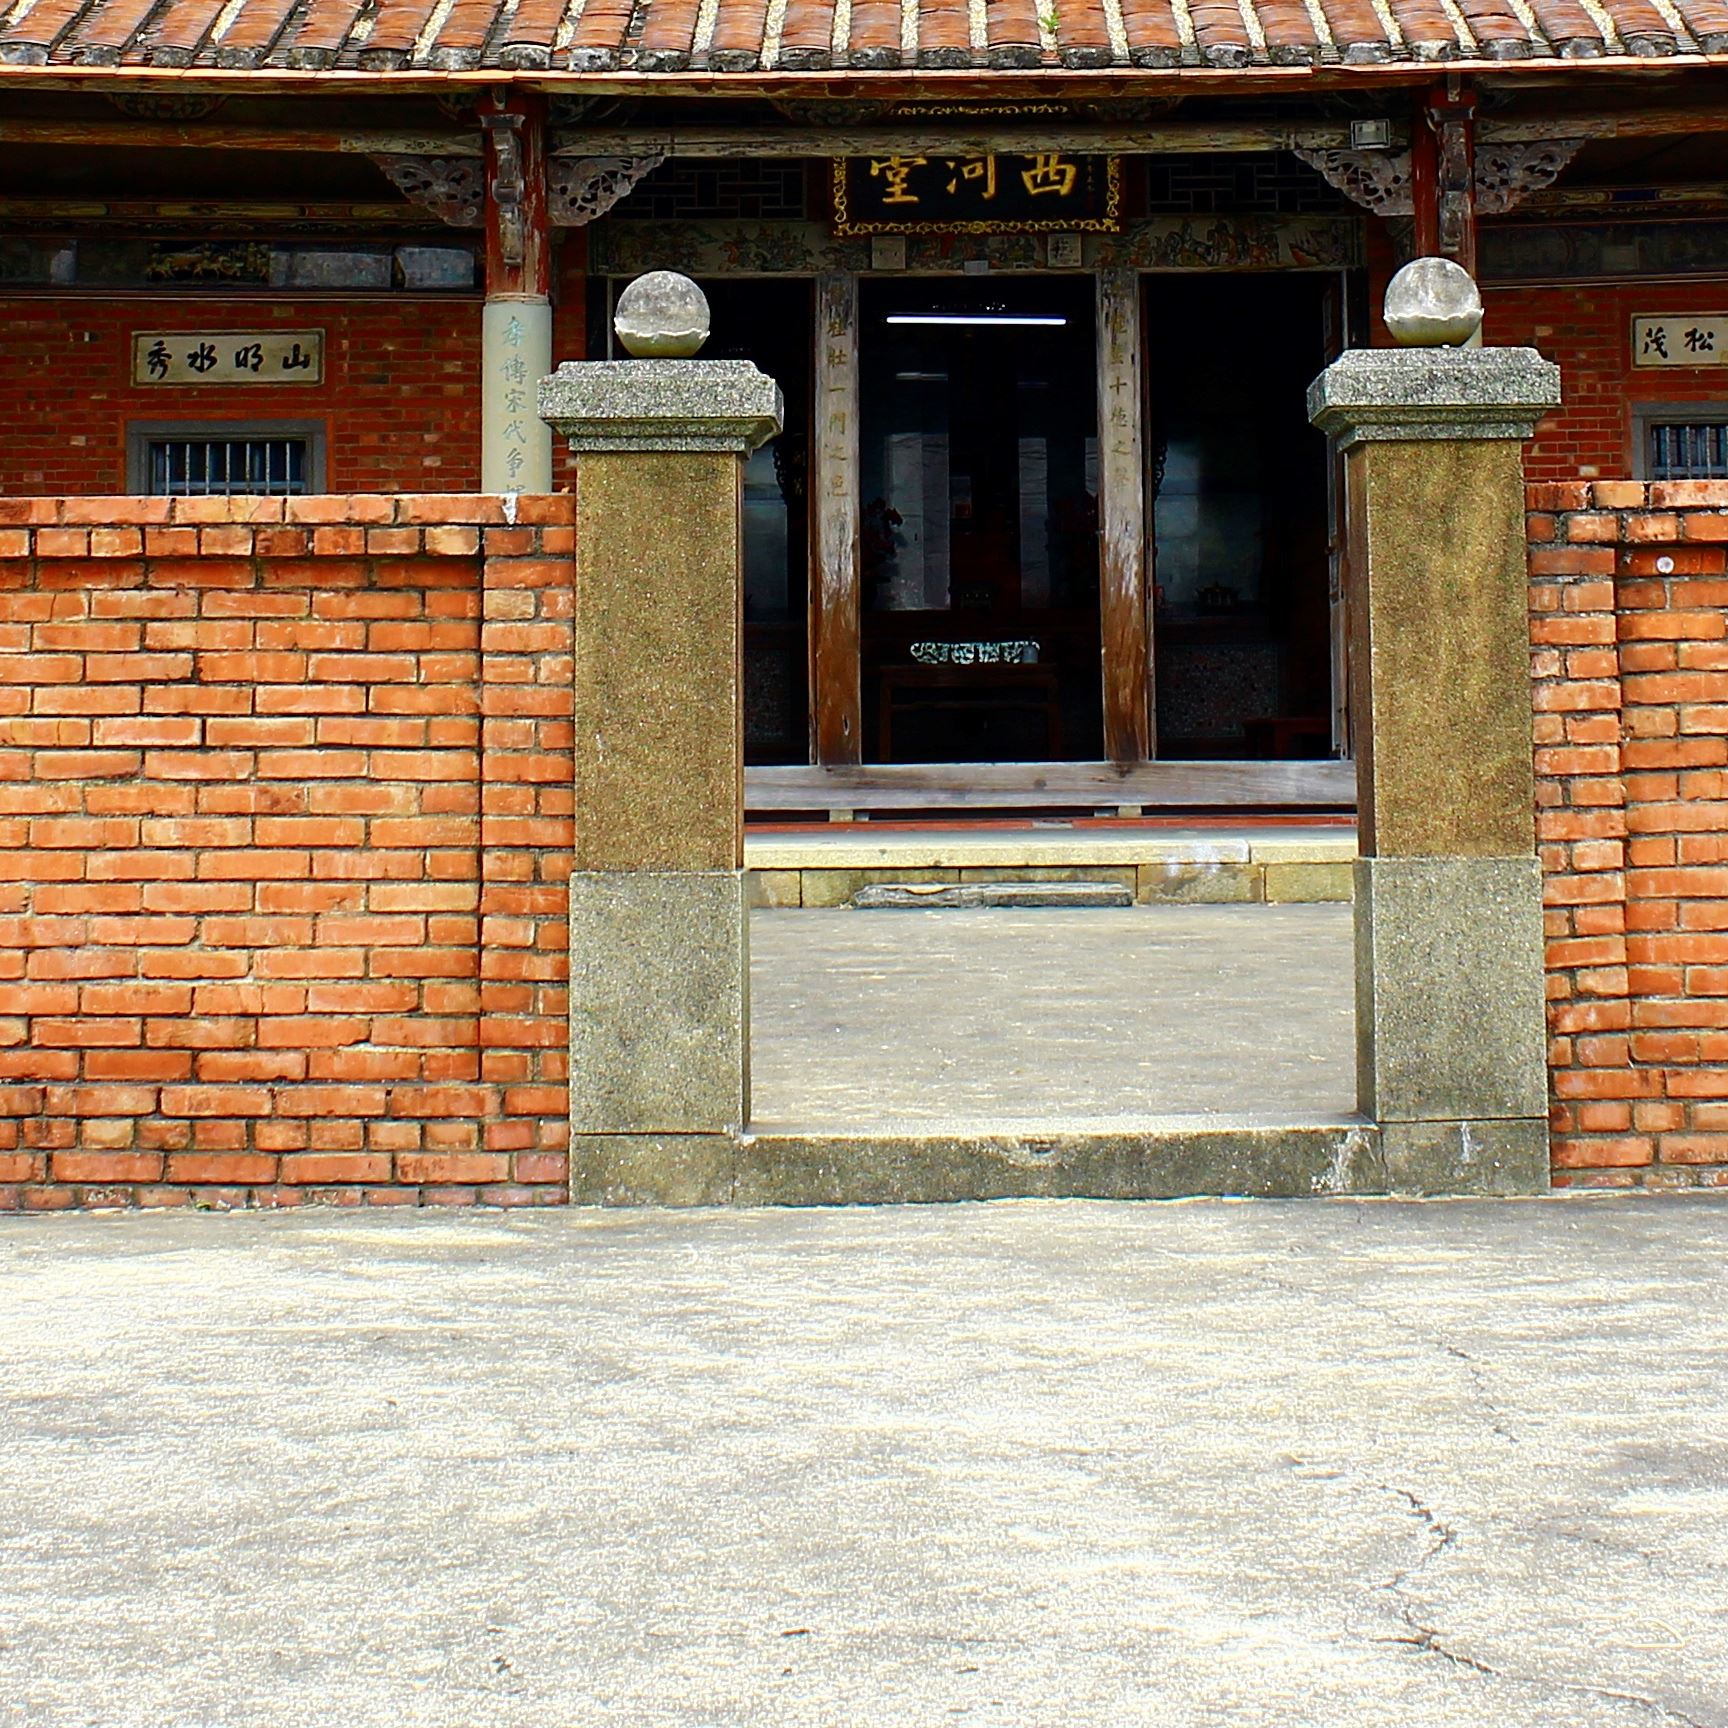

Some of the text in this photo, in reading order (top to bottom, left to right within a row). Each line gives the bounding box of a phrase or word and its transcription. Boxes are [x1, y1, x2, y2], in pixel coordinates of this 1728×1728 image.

[869, 154, 1078, 205] 西河堂
[146, 339, 311, 380] 山明水秀
